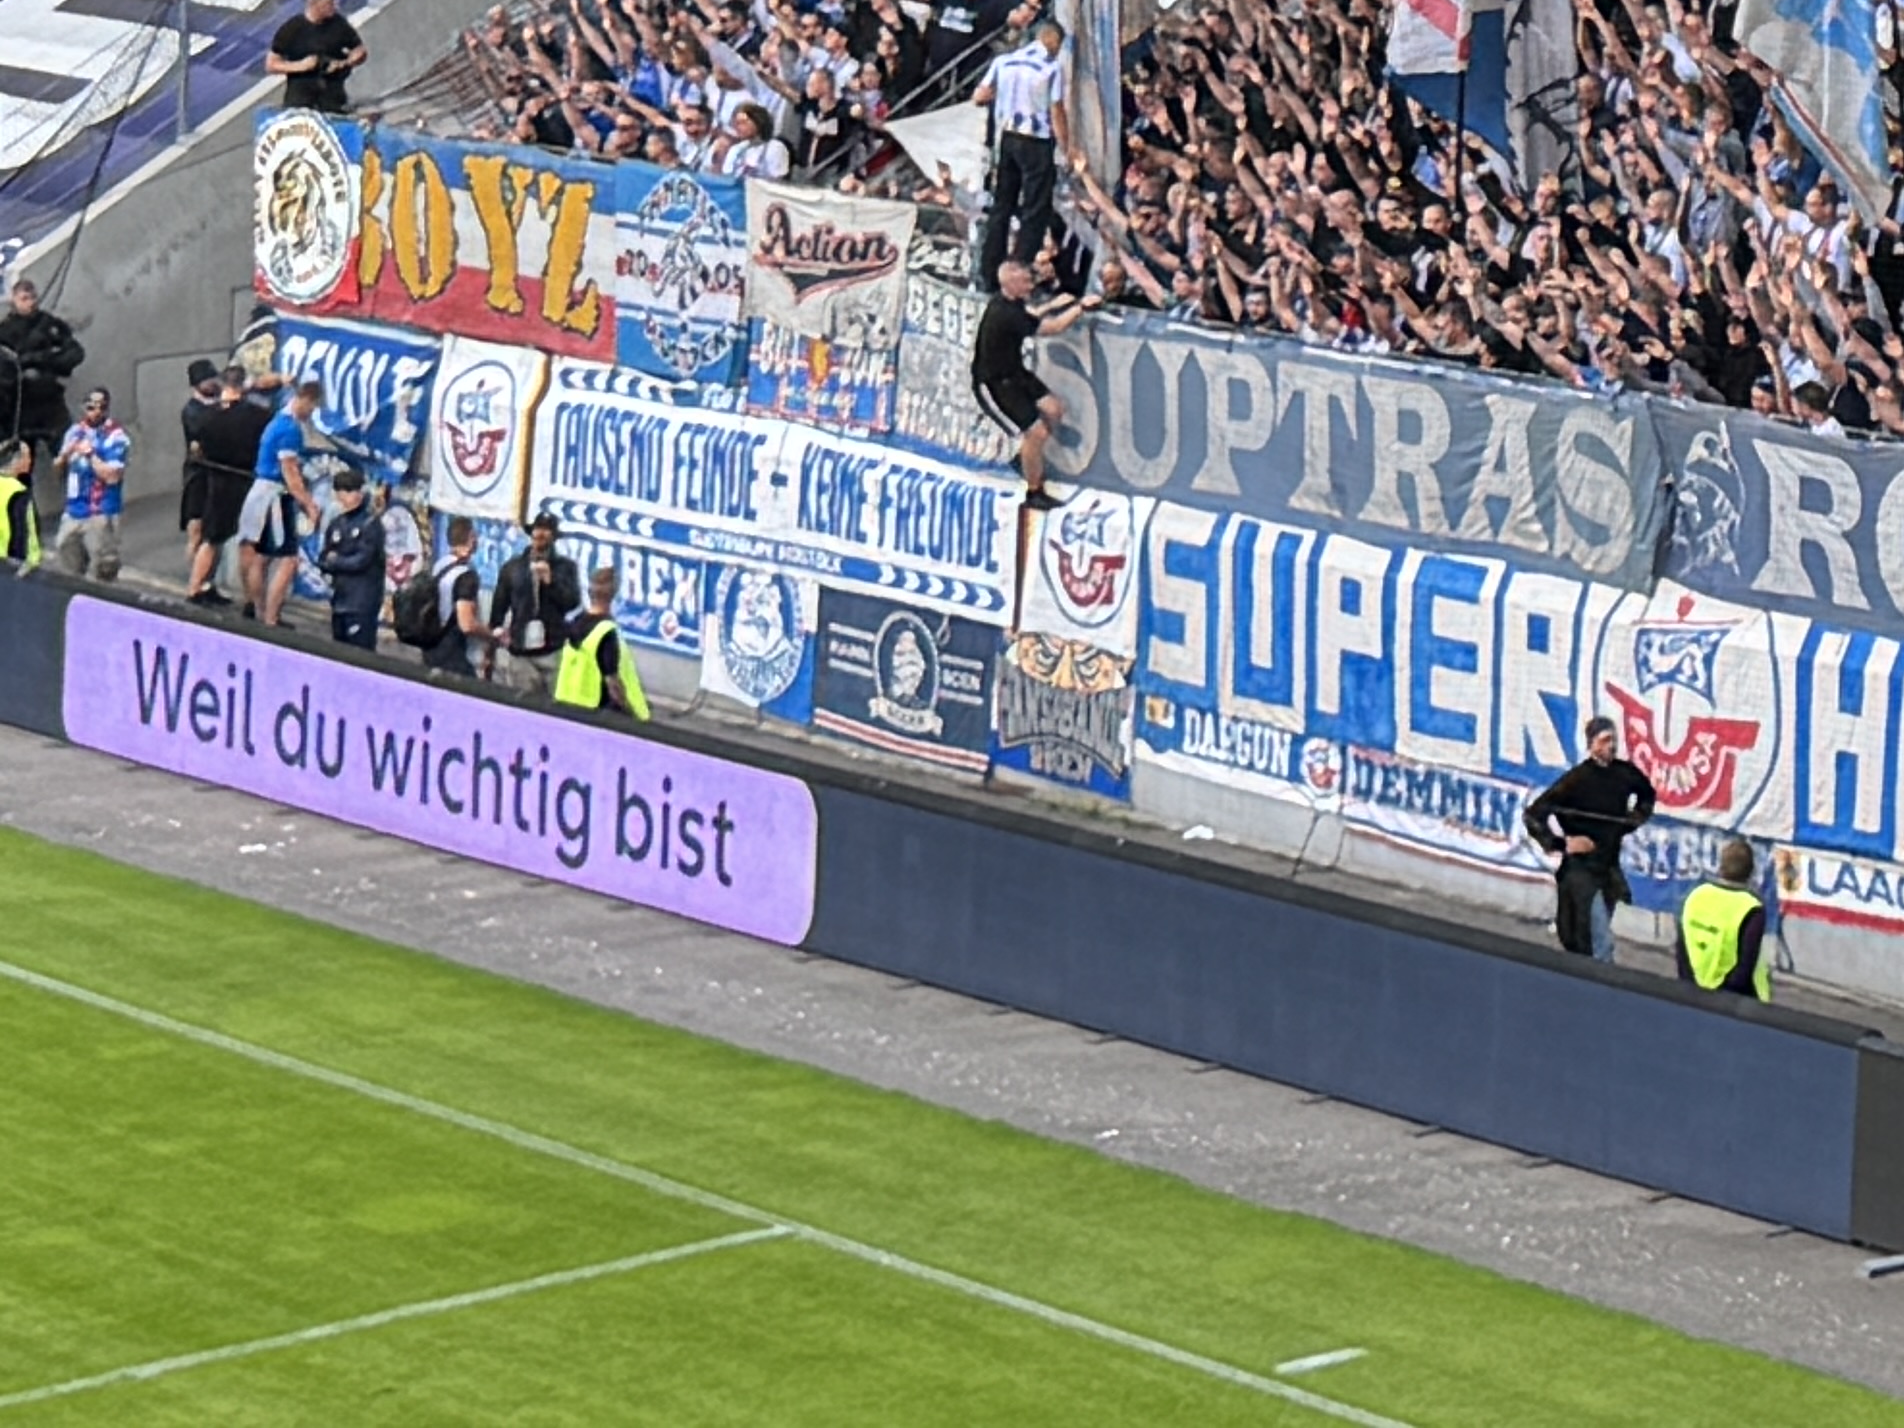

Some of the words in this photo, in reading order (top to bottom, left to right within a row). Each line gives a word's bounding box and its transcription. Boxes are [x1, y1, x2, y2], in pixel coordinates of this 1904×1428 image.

[758, 203, 891, 263] Action
[551, 401, 665, 504] TAUSEND
[672, 420, 768, 522] FEINDE
[799, 442, 880, 540] KEINE
[877, 458, 1013, 575] FREUNDE
[1034, 326, 1636, 576] SUPTRAS
[1148, 498, 1583, 769] SUPER
[132, 638, 257, 756] Weil
[273, 684, 346, 779] du
[368, 716, 592, 869] wichtig
[615, 766, 735, 888] bist
[1350, 756, 1518, 836] DEMMIN
